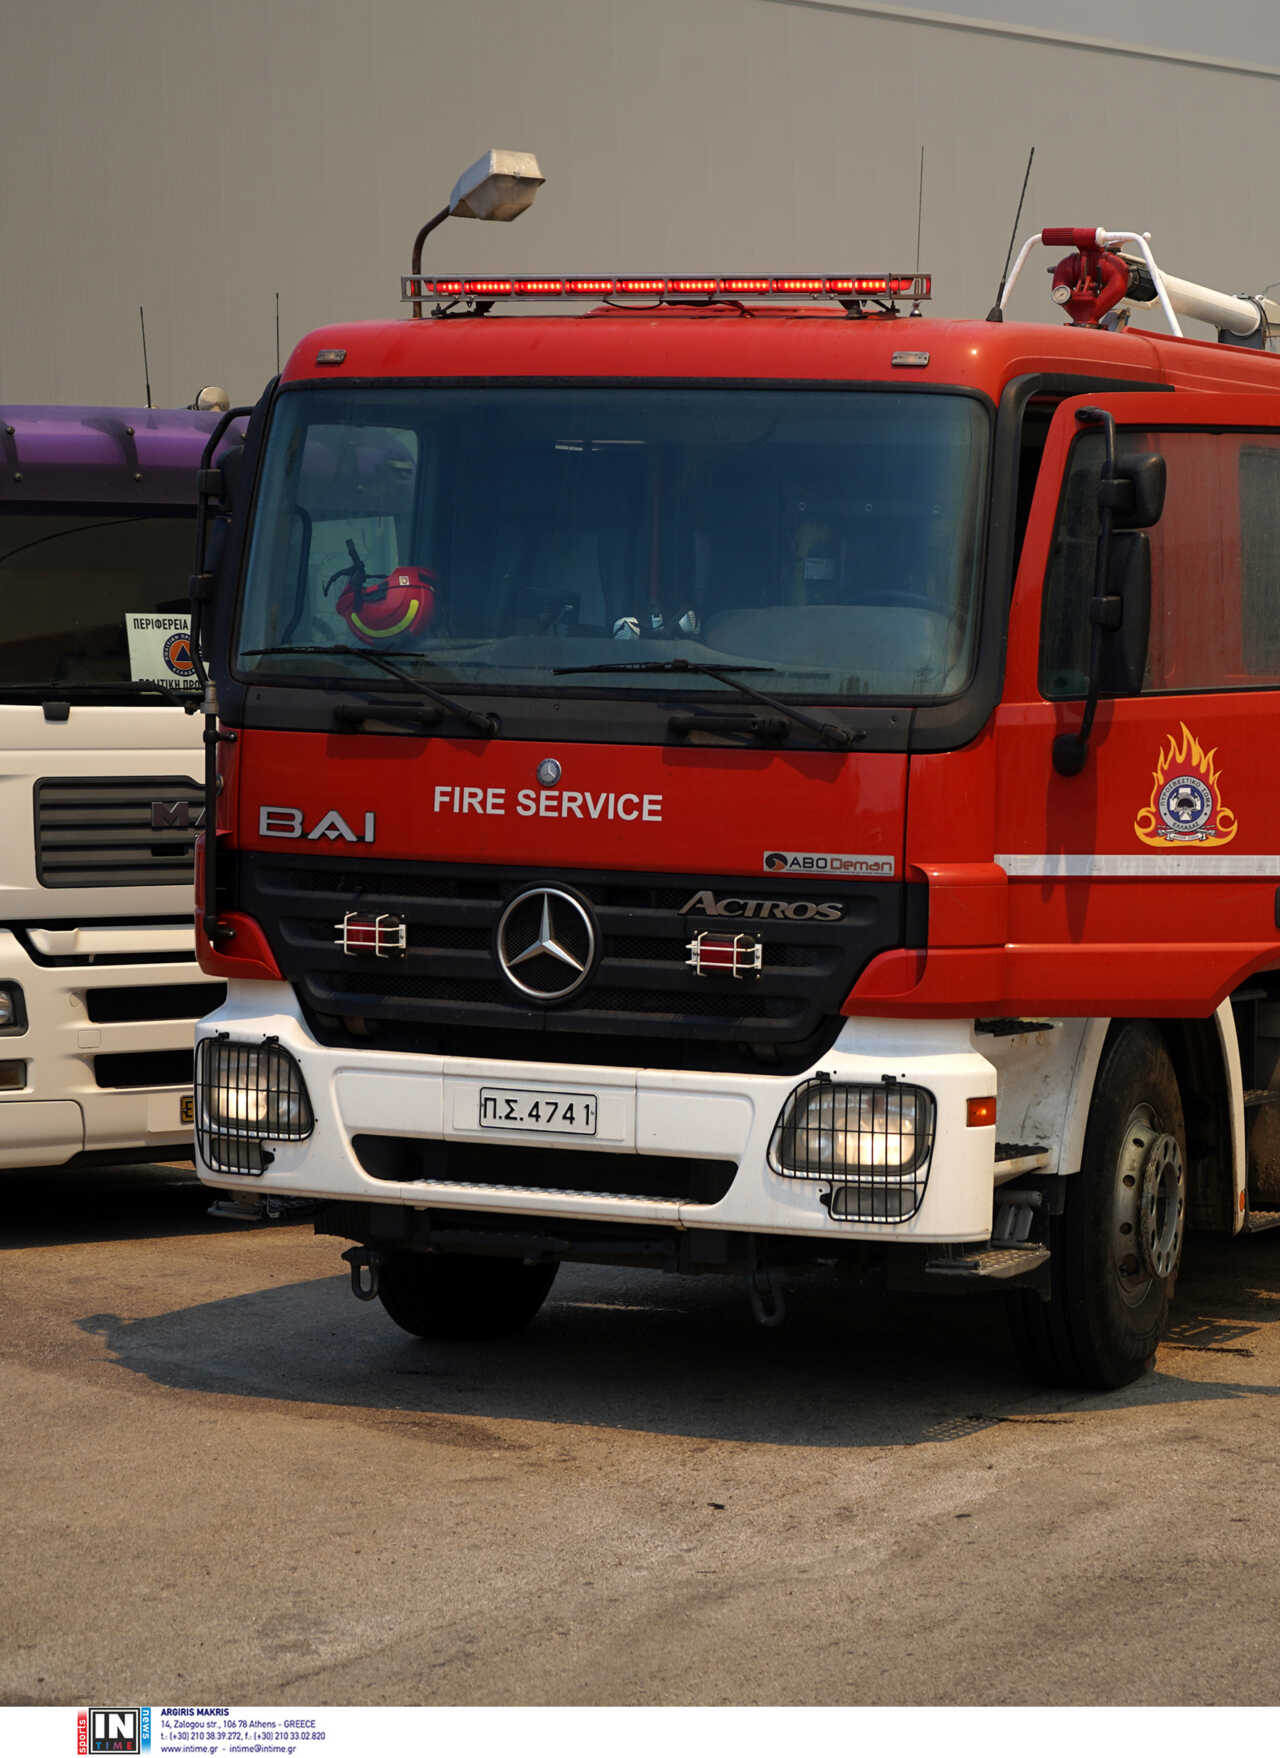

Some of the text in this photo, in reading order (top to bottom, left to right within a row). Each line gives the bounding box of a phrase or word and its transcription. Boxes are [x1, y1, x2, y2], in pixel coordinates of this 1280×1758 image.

[133, 617, 189, 631] ΠΕΡΙΦΕΡΕΙΑ
[433, 786, 664, 822] FIRE SERVICE
[258, 805, 375, 843] BAI
[789, 856, 893, 872] ABO Deman
